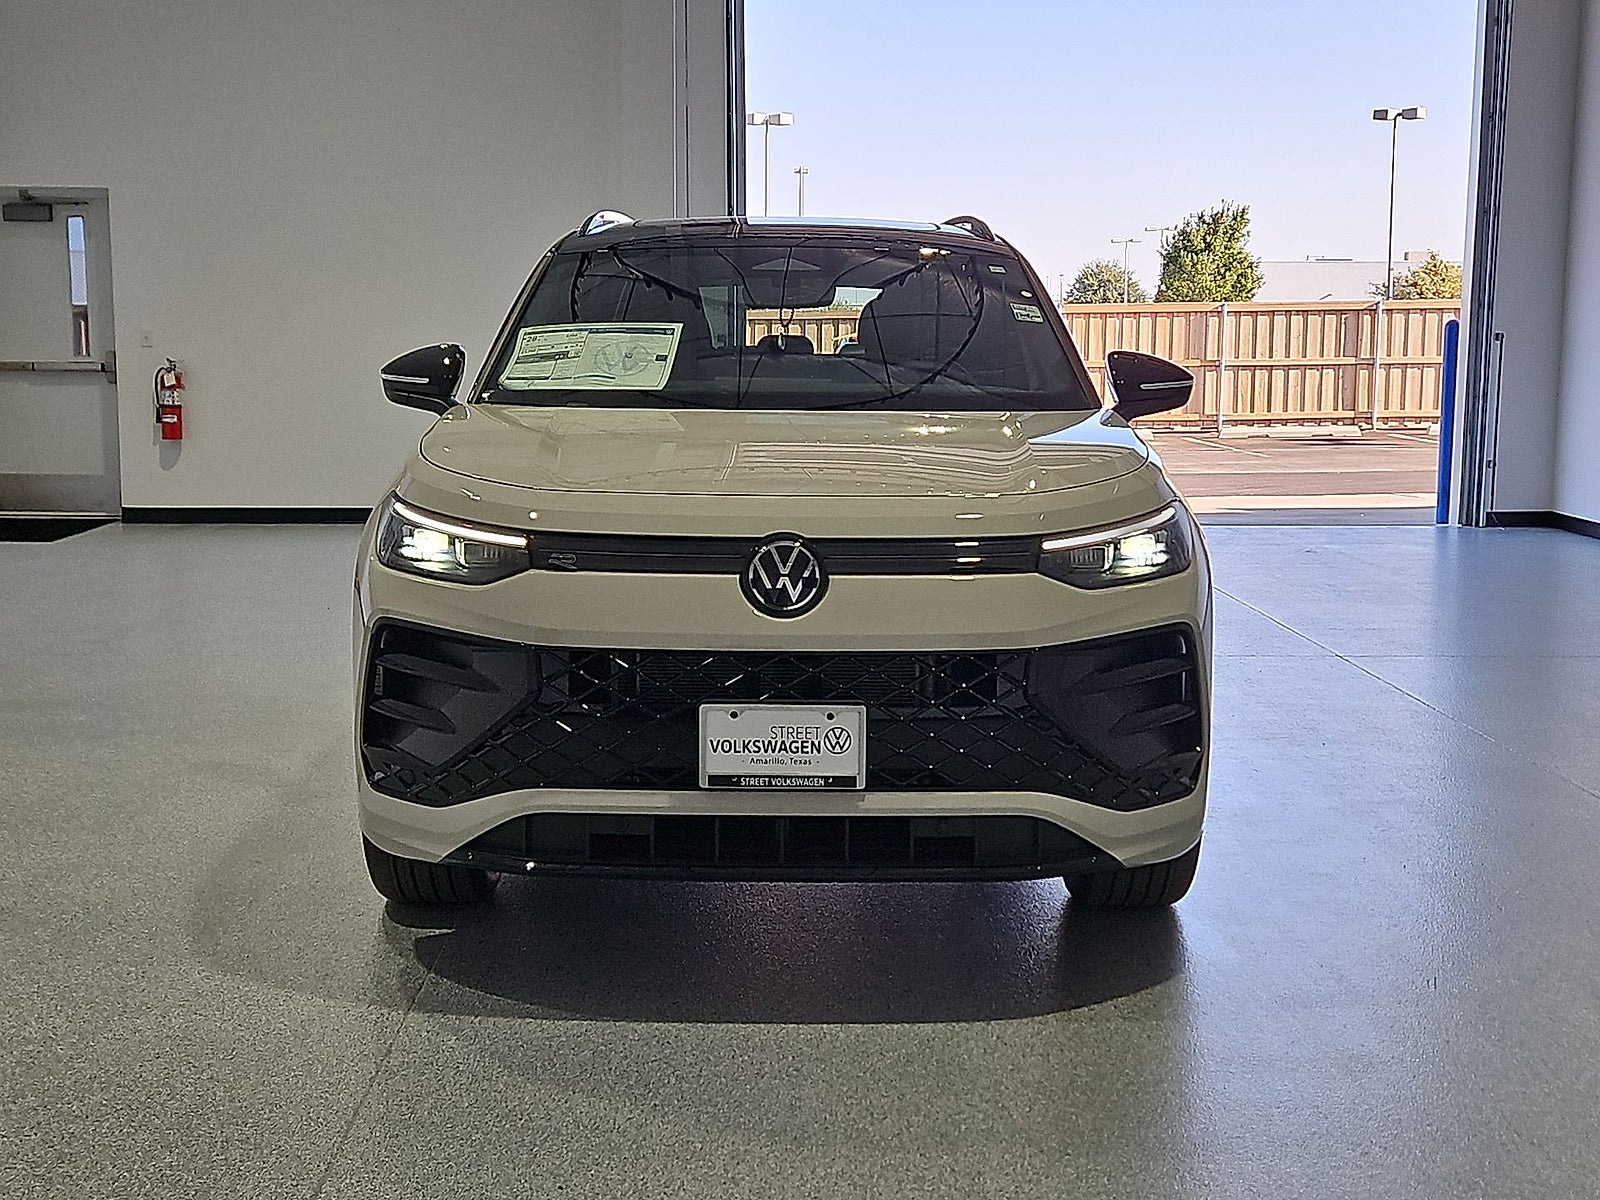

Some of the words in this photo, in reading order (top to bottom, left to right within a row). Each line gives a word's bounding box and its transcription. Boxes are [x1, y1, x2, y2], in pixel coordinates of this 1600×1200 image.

[770, 725, 821, 740] STREET
[709, 739, 822, 755] VOLKSWAGEN
[749, 757, 787, 766] Amarillo,
[789, 757, 812, 766] Texas
[740, 777, 769, 786] STREET
[771, 777, 825, 787] VOLKSWAGEN
